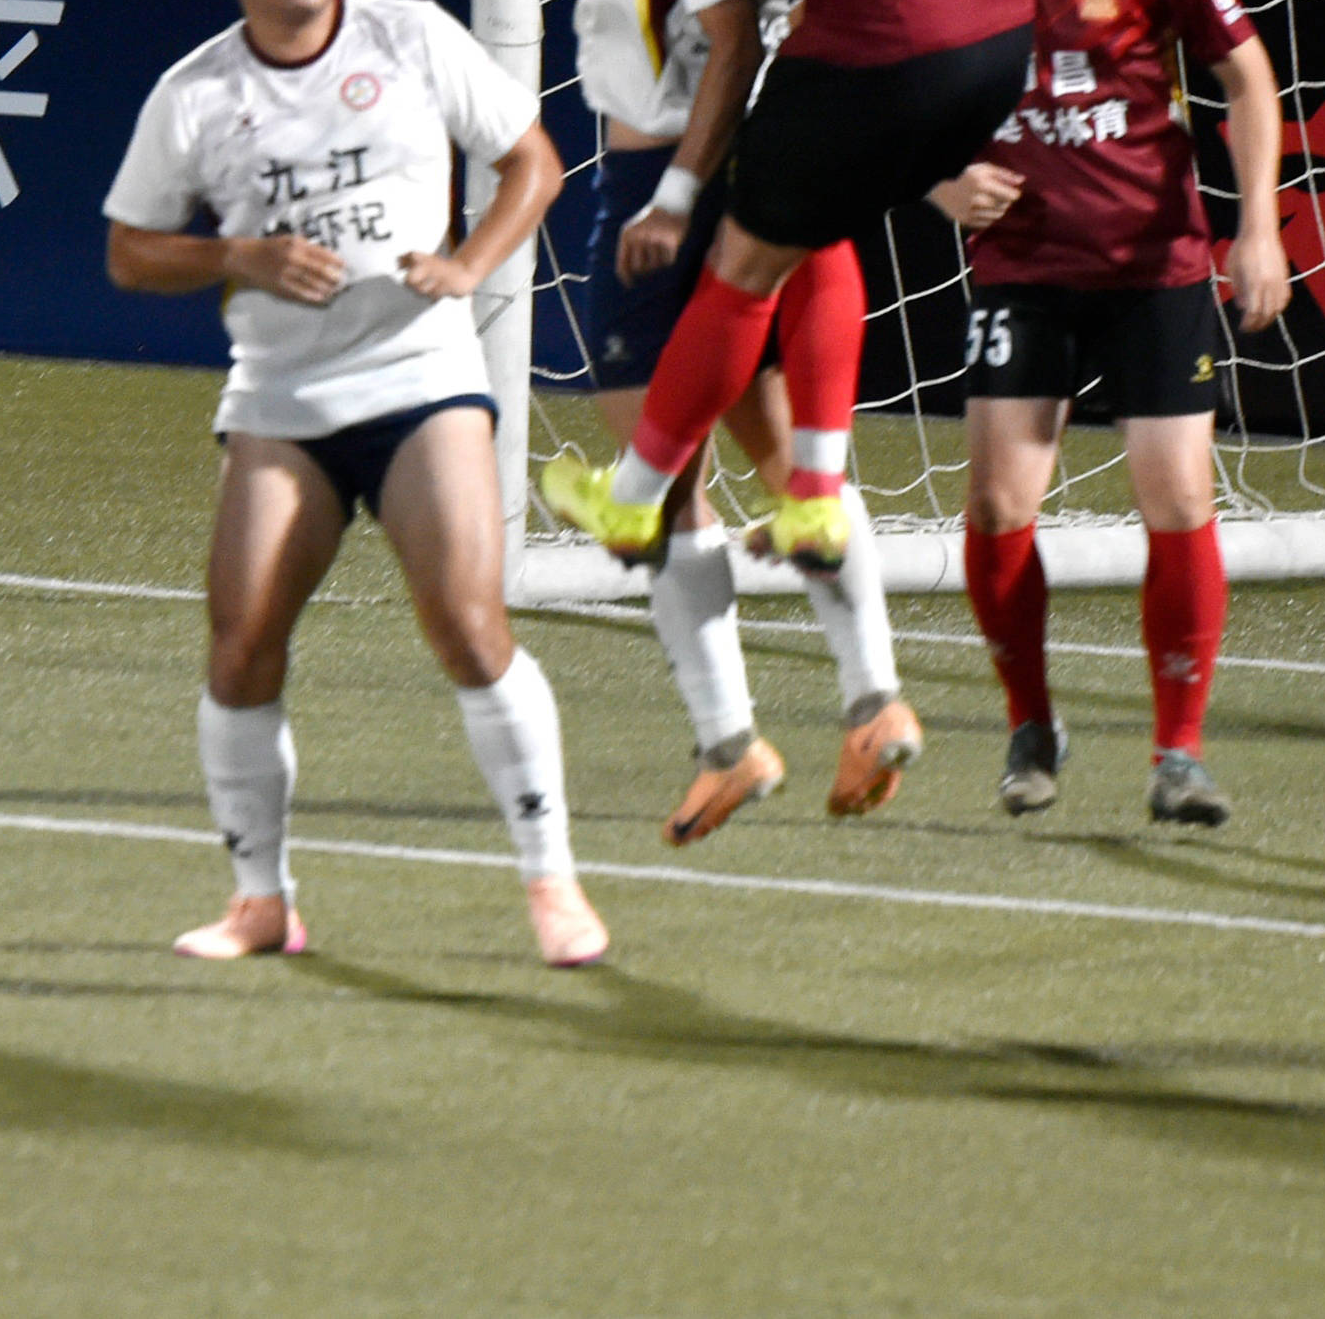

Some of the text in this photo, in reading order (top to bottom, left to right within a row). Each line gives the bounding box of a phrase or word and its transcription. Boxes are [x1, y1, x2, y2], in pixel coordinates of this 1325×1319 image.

[1024, 50, 1097, 98] 昌
[260, 145, 371, 208] 九江
[964, 306, 1013, 368] 55
